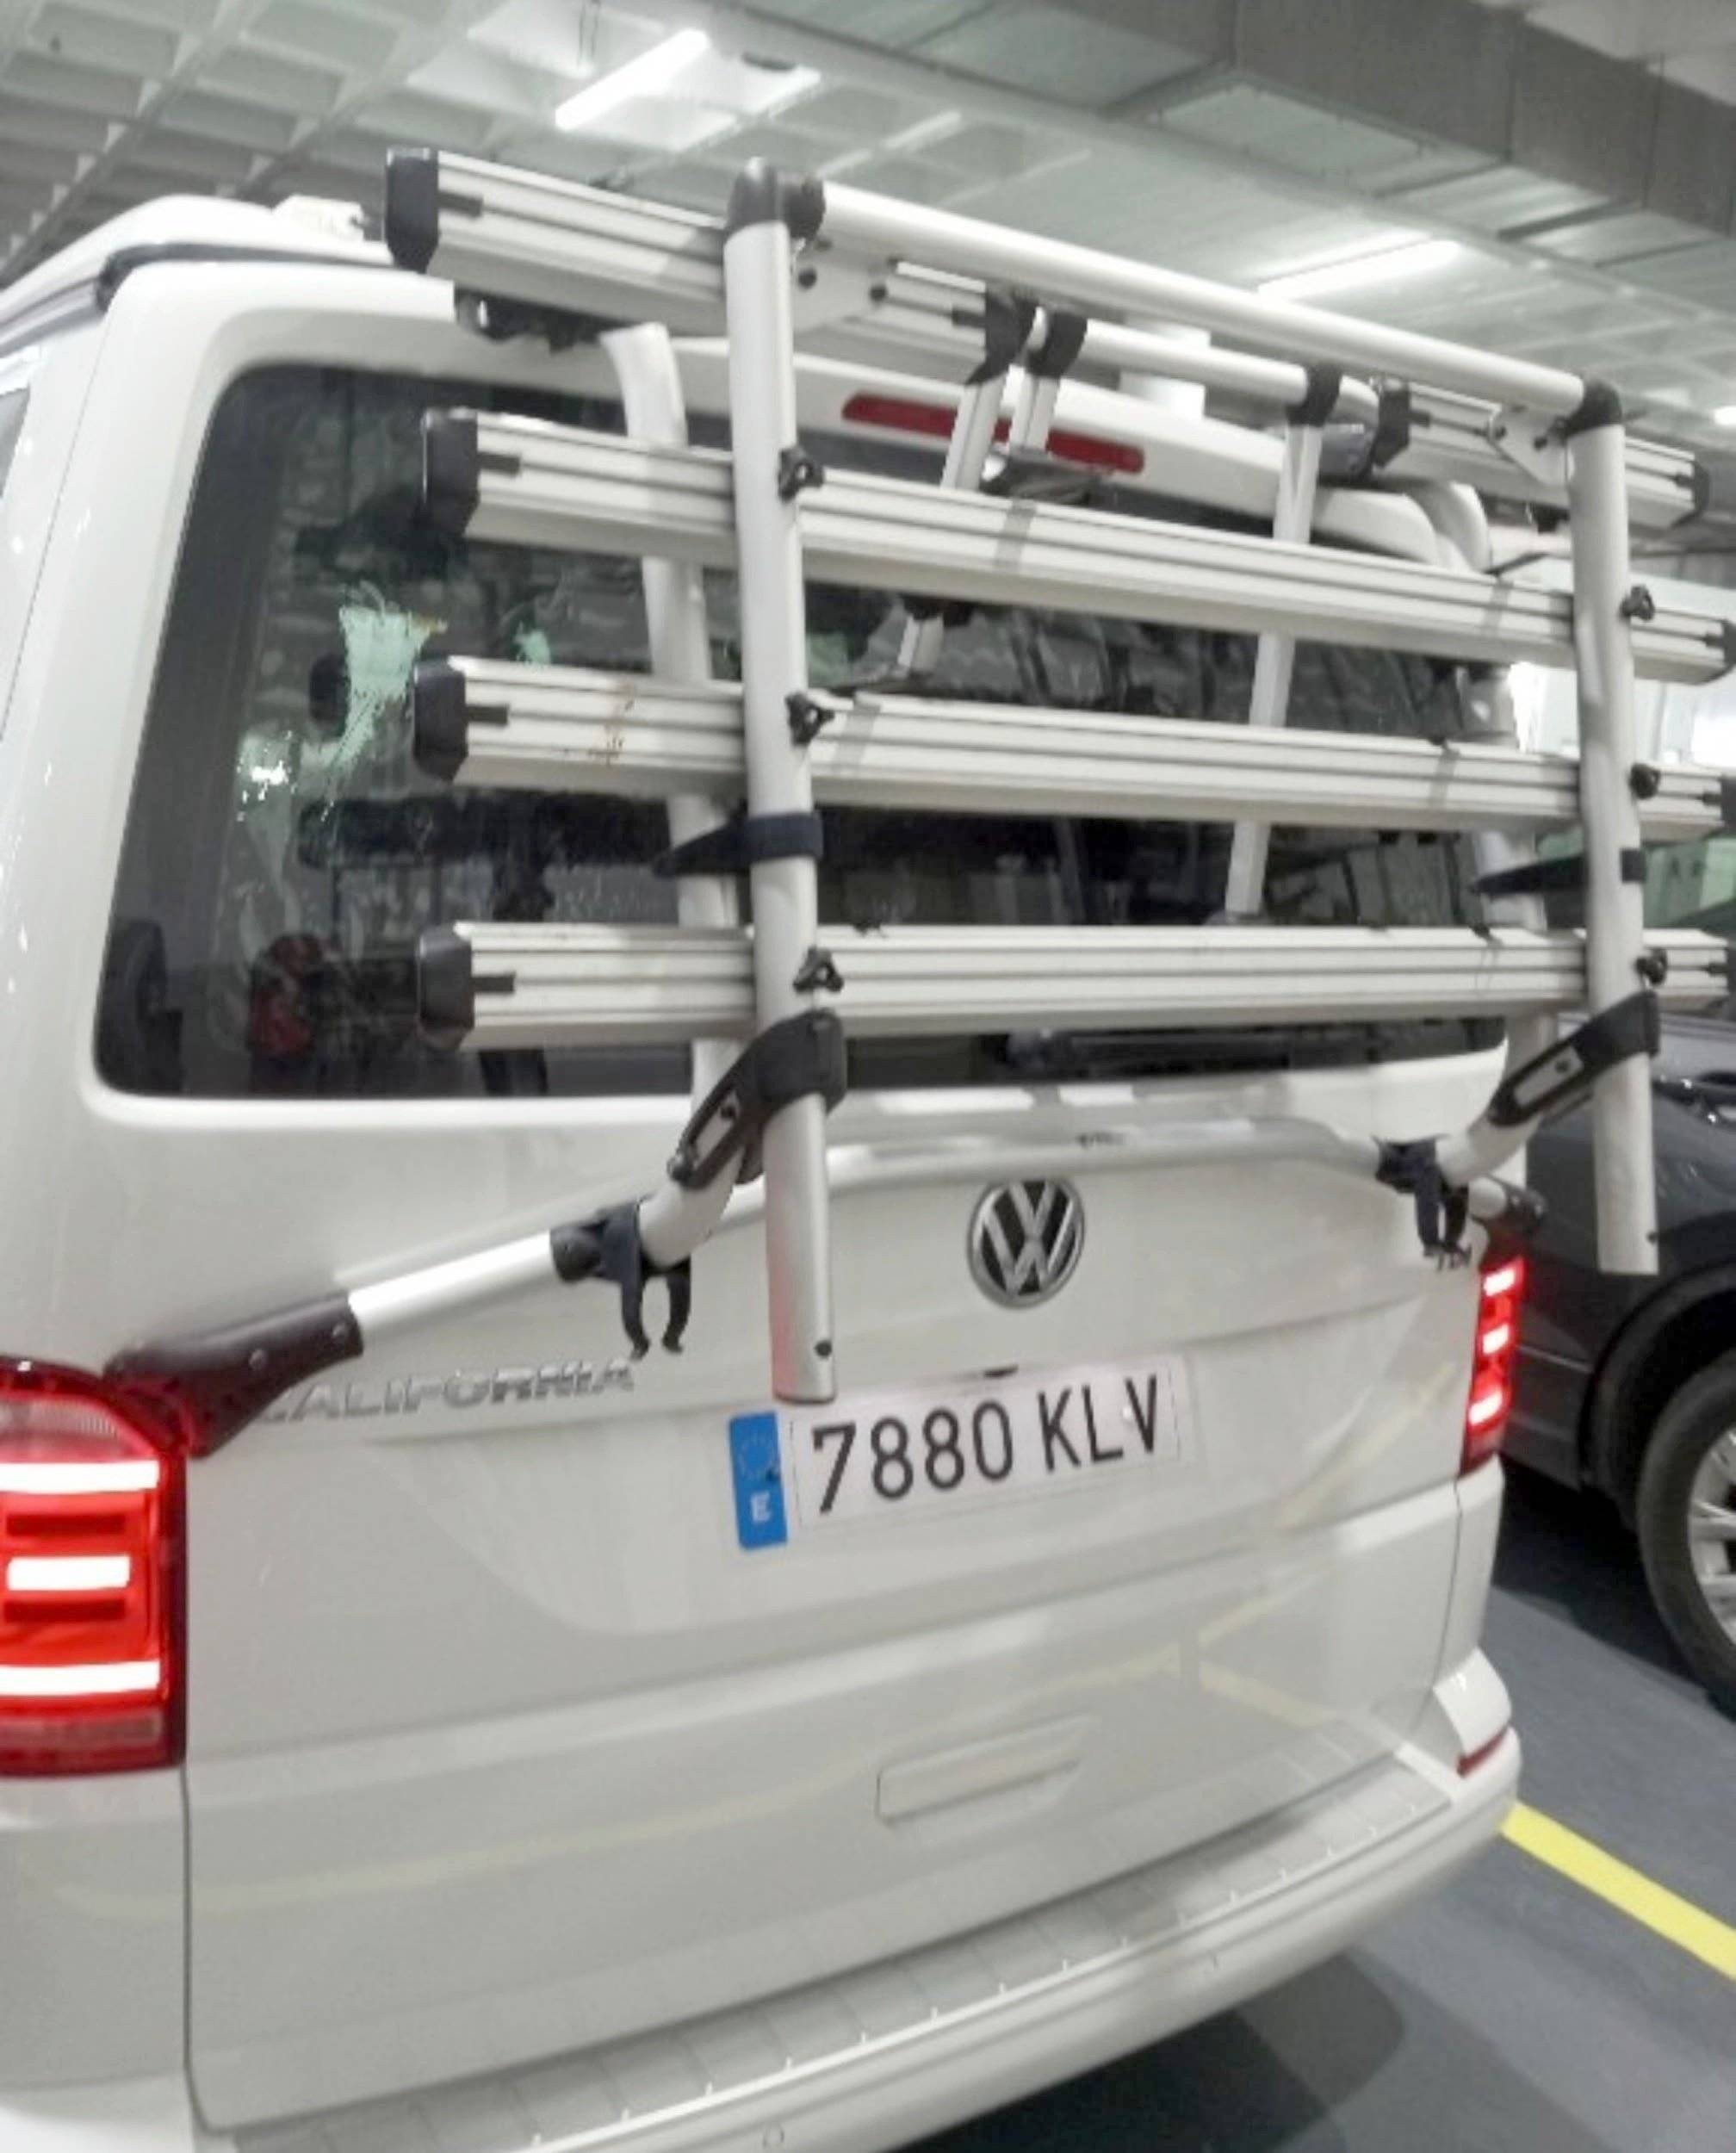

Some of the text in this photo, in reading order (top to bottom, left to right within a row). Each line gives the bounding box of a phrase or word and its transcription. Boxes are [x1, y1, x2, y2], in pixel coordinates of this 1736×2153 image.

[812, 1374, 1157, 1514] 7880 KLV
[750, 1492, 772, 1523] E
